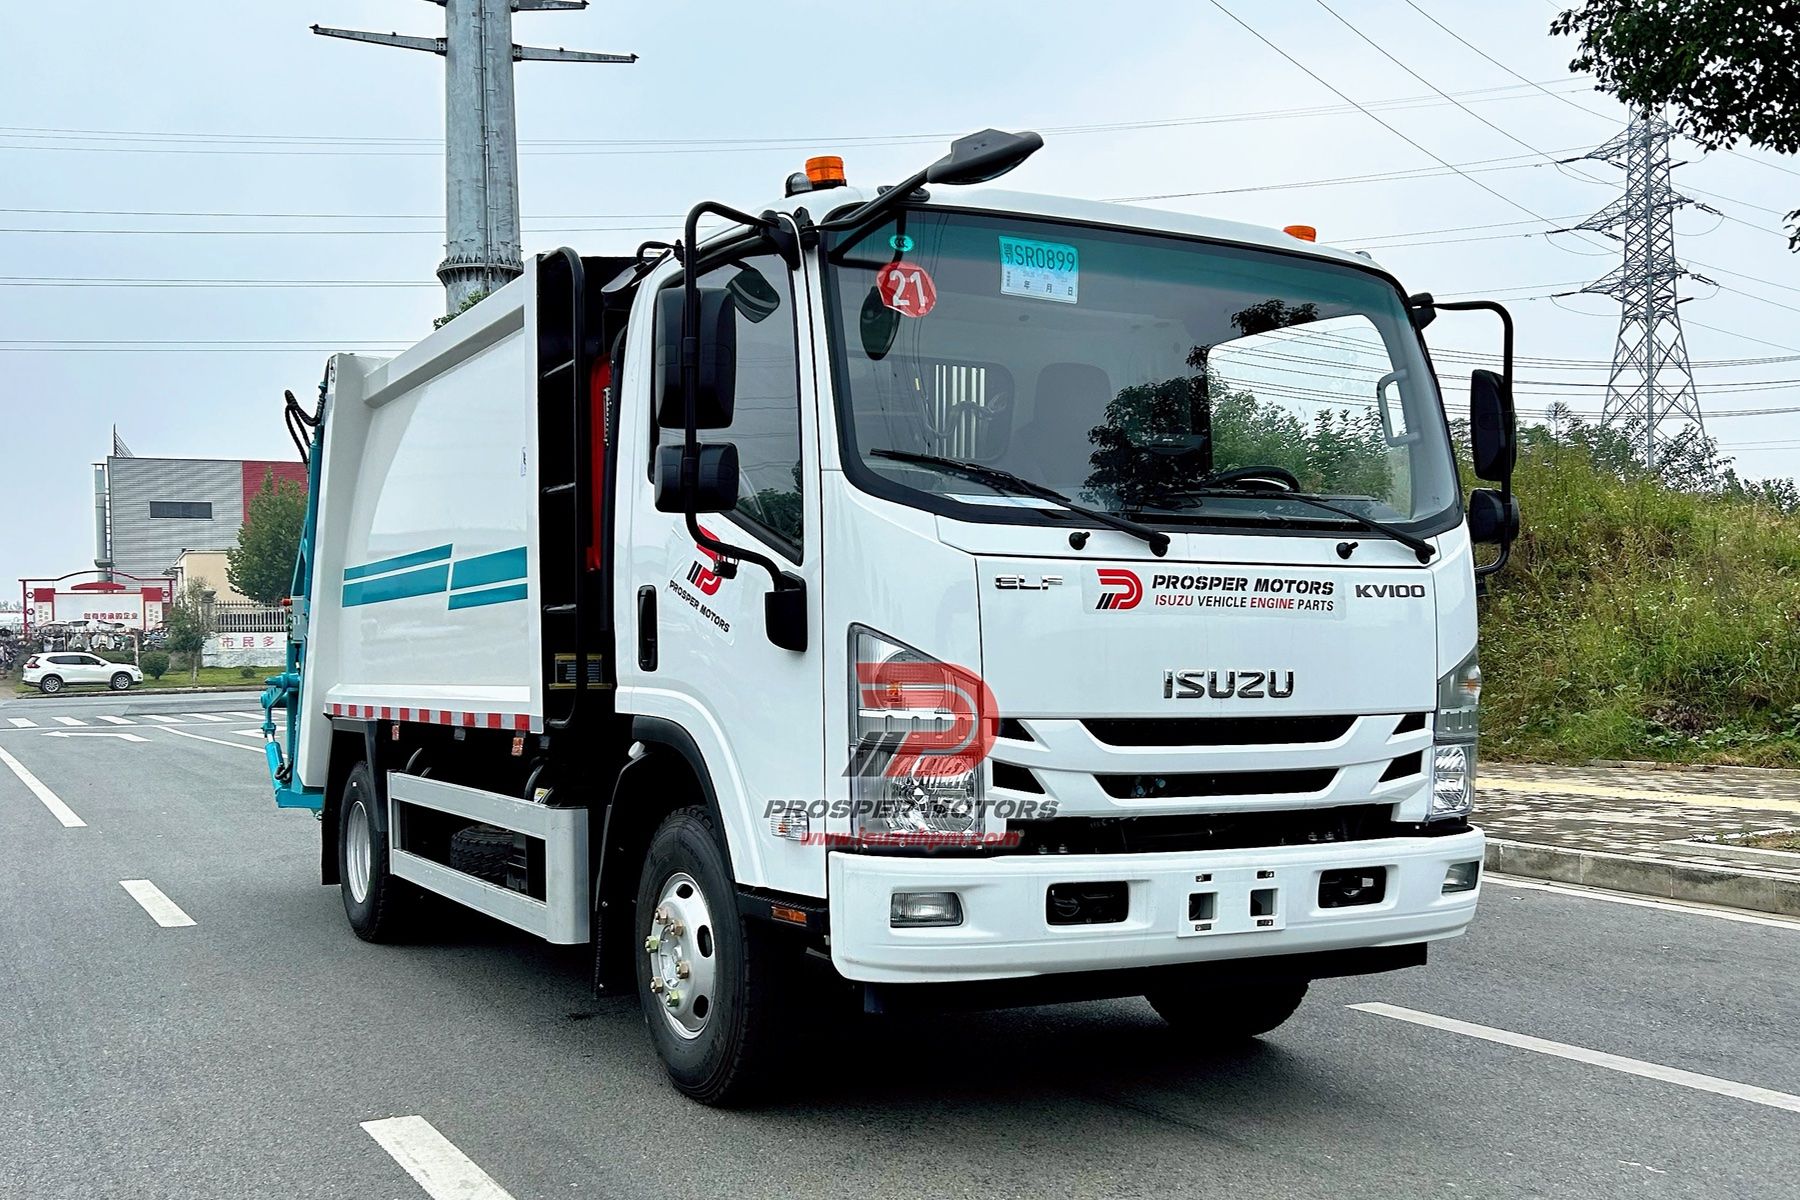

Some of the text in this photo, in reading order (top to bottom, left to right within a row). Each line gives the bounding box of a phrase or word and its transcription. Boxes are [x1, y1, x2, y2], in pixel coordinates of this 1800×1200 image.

[889, 269, 927, 307] 21
[1046, 283, 1052, 293] 月
[994, 573, 1063, 590] ELF
[1151, 573, 1334, 596] PROSPER MOTORS
[1355, 584, 1426, 598] KV100
[669, 580, 730, 633] PROSPER MOTORS
[1155, 594, 1334, 611] ISUZU VEHICLE ENGINE PARTS
[222, 636, 286, 648] 市民多
[1162, 668, 1295, 699] ISUZU
